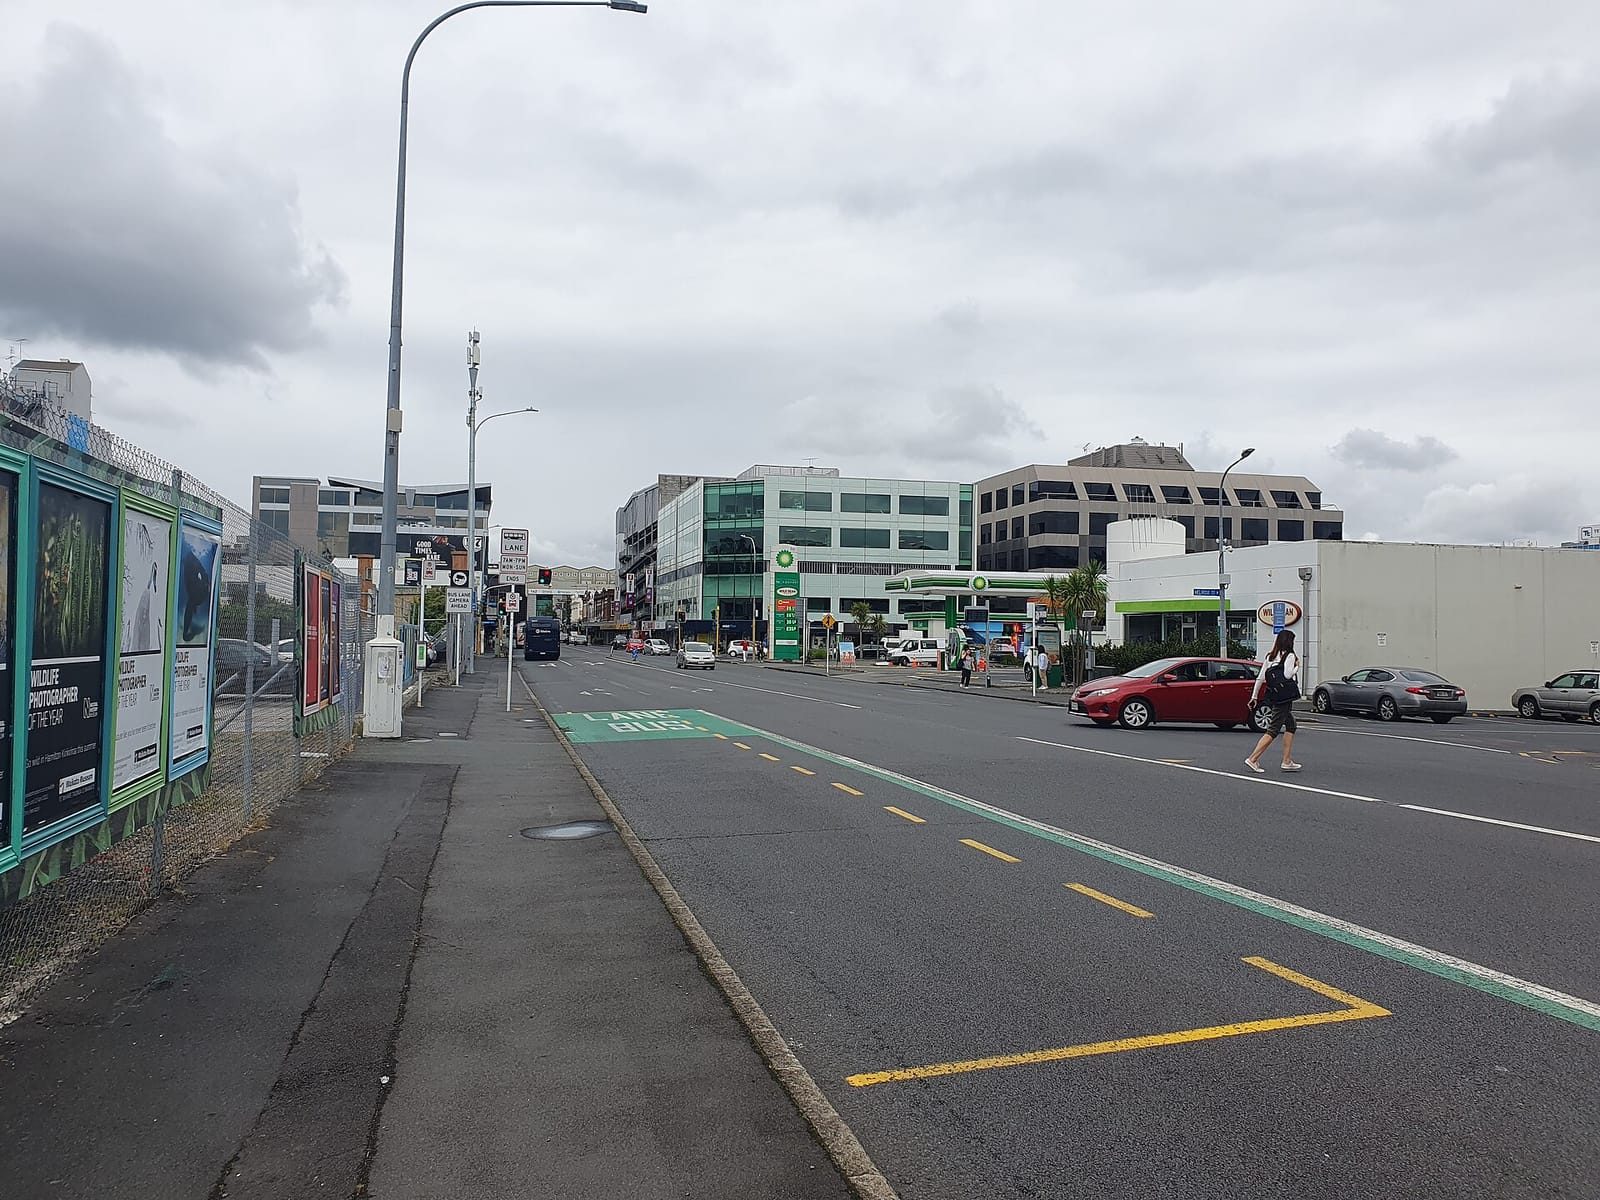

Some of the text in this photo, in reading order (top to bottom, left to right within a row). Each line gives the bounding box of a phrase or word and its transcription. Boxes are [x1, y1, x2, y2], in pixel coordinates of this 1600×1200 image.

[504, 544, 525, 552] LANE
[30, 668, 60, 688] WILDLIFE
[28, 686, 79, 709] PHOTOGRAPHER
[37, 710, 48, 729] THE
[49, 708, 64, 727] YEAR
[583, 709, 681, 722] LANE
[607, 720, 695, 733] BUS
